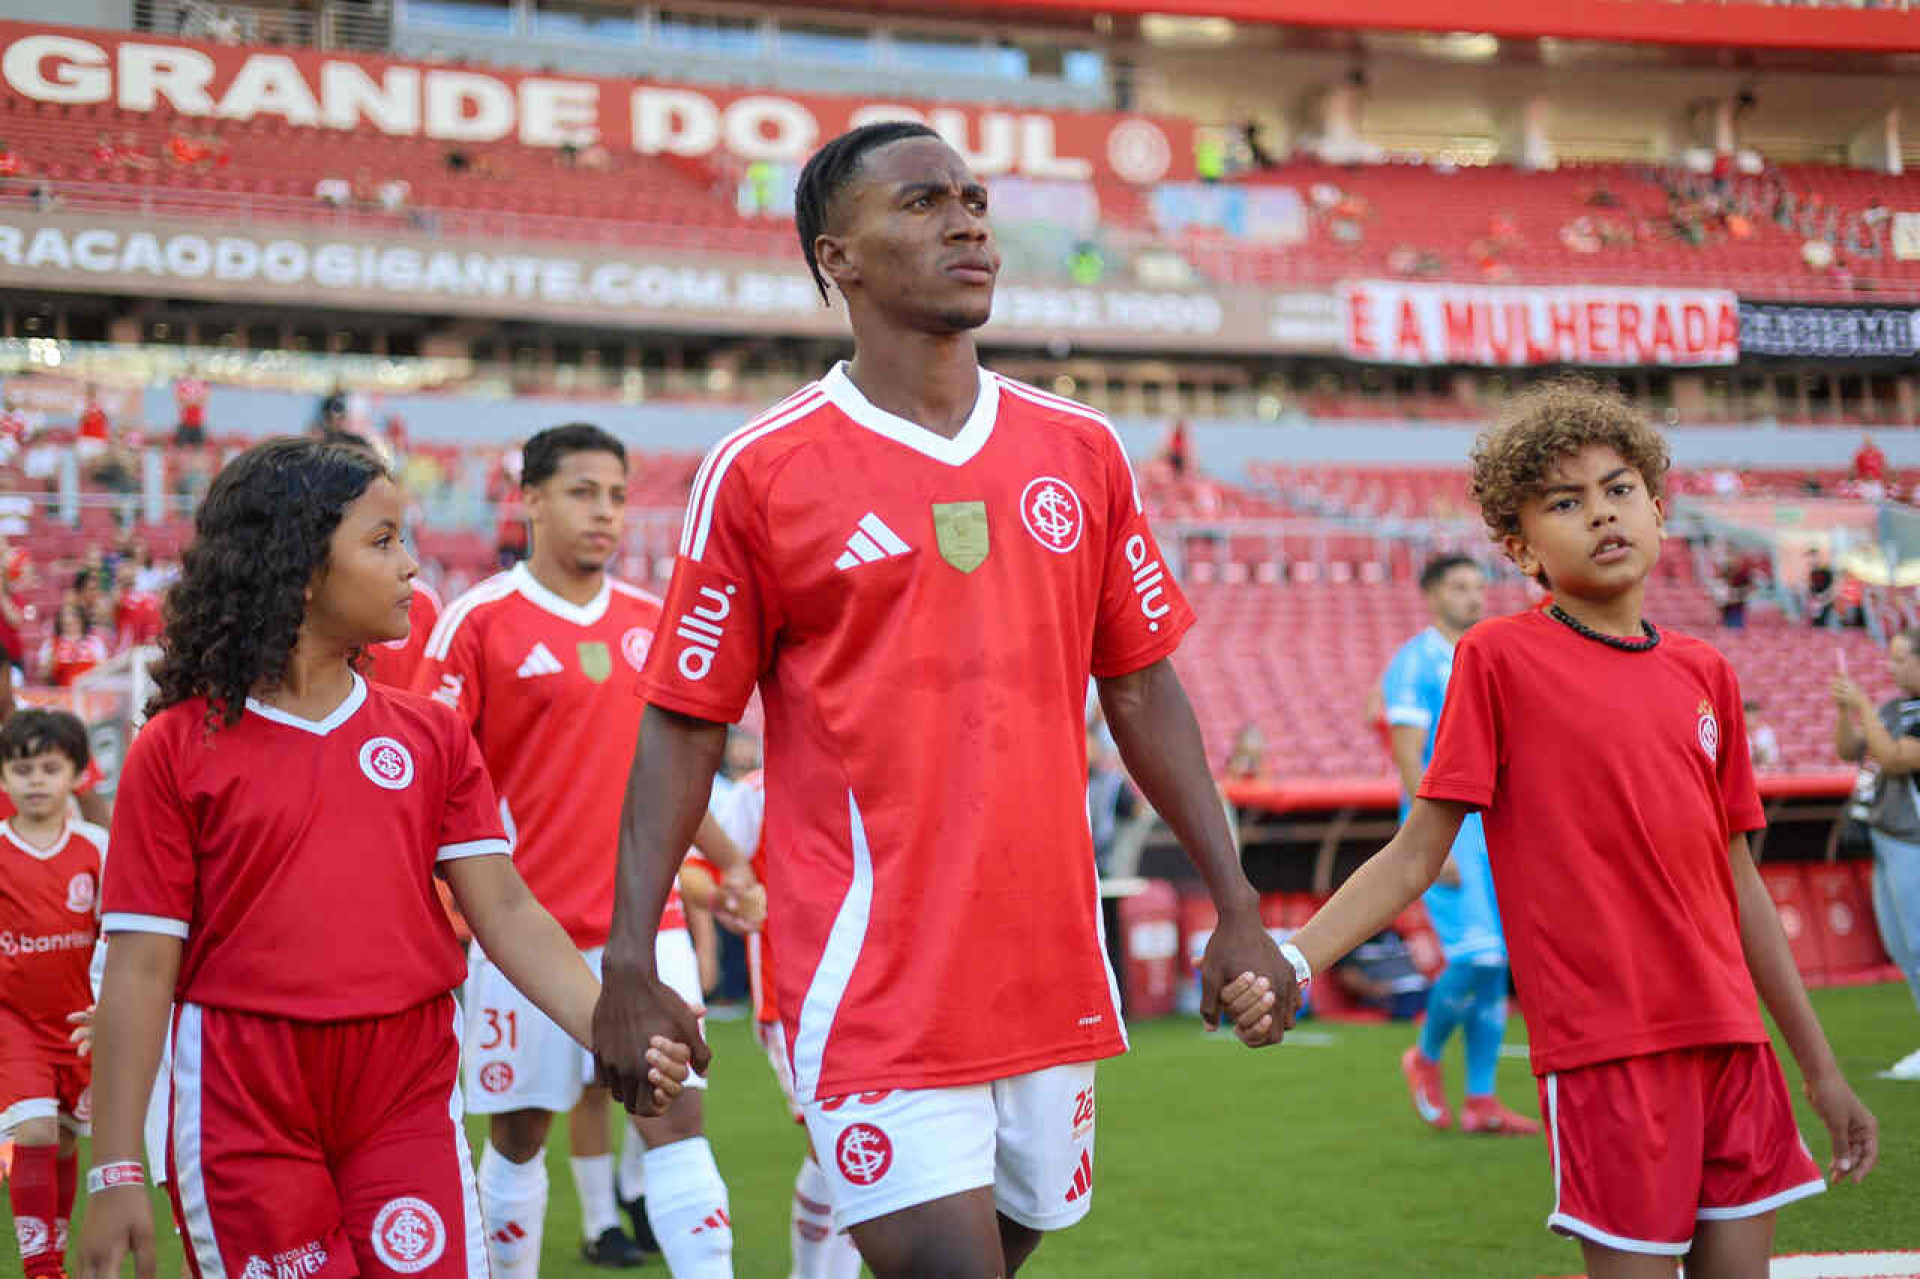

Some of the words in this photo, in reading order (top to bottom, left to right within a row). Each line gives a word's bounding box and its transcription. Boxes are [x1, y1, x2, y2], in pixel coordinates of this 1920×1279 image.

[2, 35, 601, 147] GRANDE
[630, 87, 819, 161] DO
[1395, 299, 1427, 362] A
[1441, 299, 1739, 364] MULHERADA
[1125, 534, 1170, 632] allu.
[677, 584, 736, 681] allu.
[479, 1008, 517, 1051] 31
[276, 1250, 328, 1279] INTER
